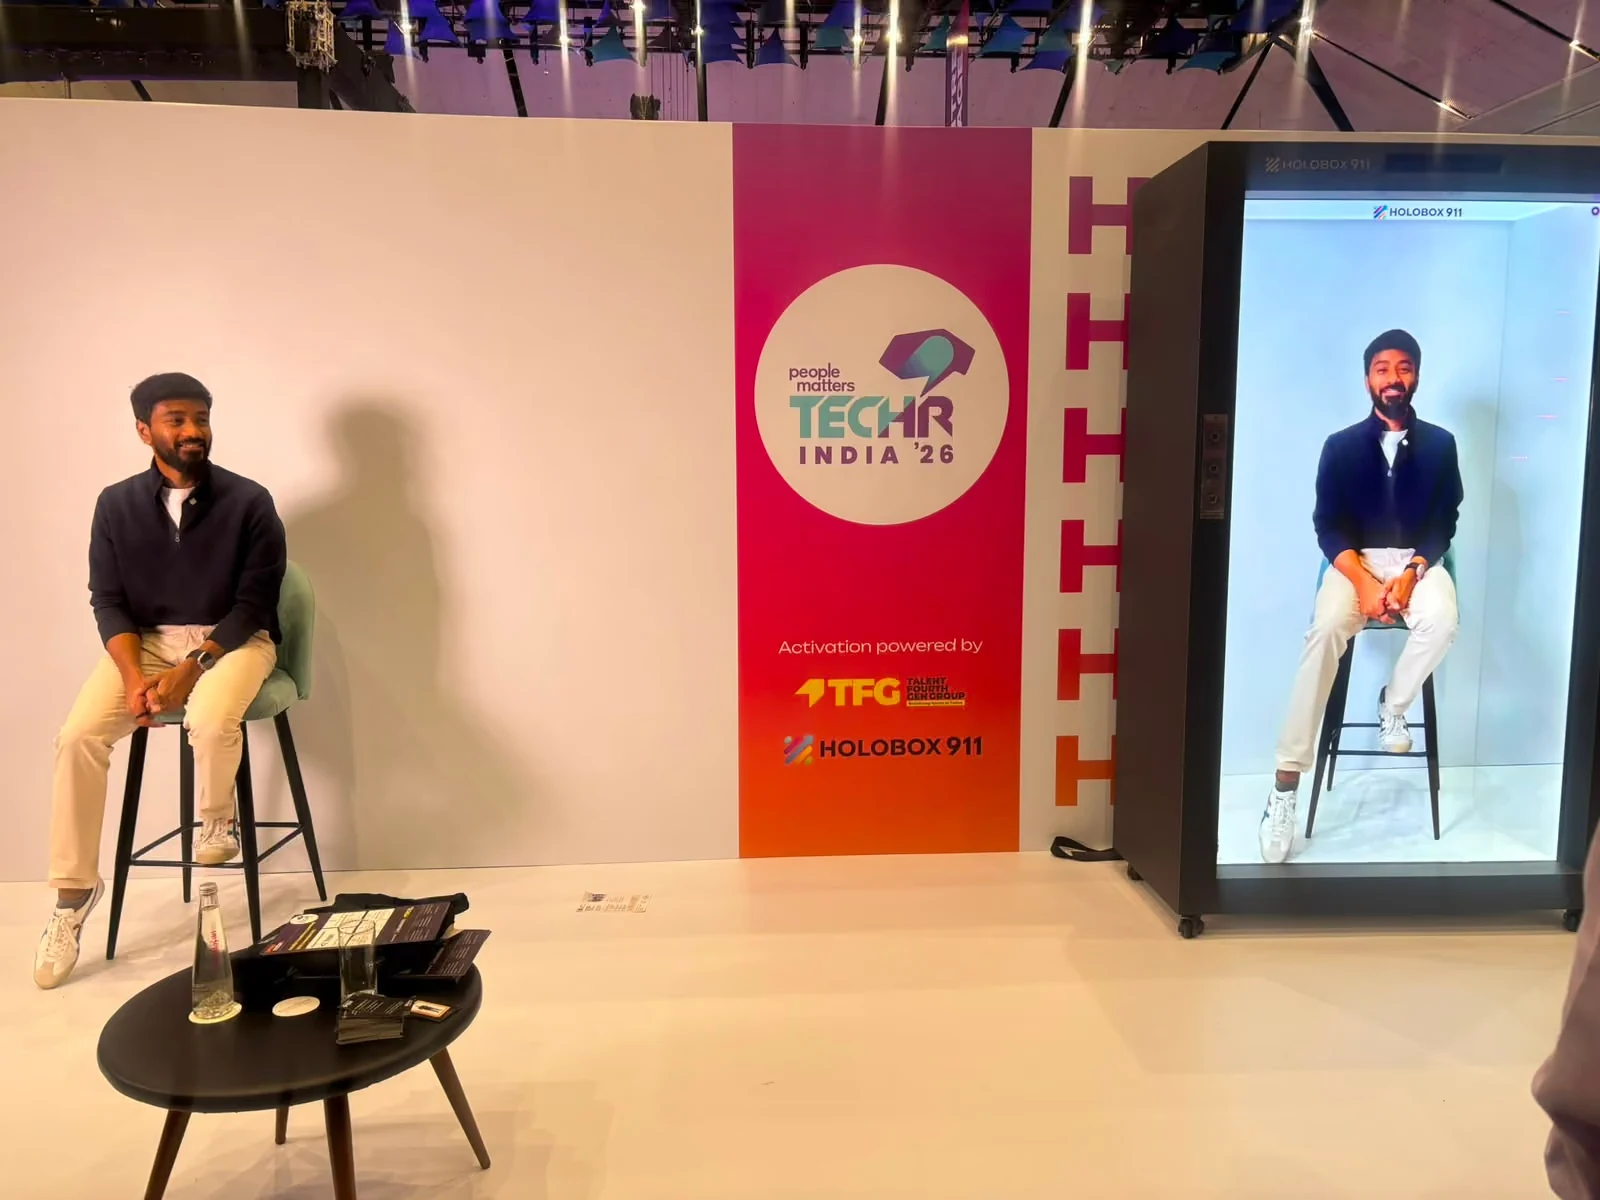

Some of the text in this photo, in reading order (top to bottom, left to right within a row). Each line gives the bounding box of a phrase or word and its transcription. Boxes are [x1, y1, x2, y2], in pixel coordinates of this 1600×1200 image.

[1282, 158, 1370, 170] HOLOBOX 911
[1389, 207, 1463, 218] HOLOBOX 911
[789, 363, 840, 381] people
[797, 380, 855, 392] matters
[799, 442, 954, 465] INDIA '26
[778, 638, 983, 655] Activation powered by
[907, 677, 947, 685] TALENT
[827, 677, 901, 706] TFG
[907, 692, 966, 700] GEN GROUP
[819, 736, 982, 757] HOLOBOX 911
